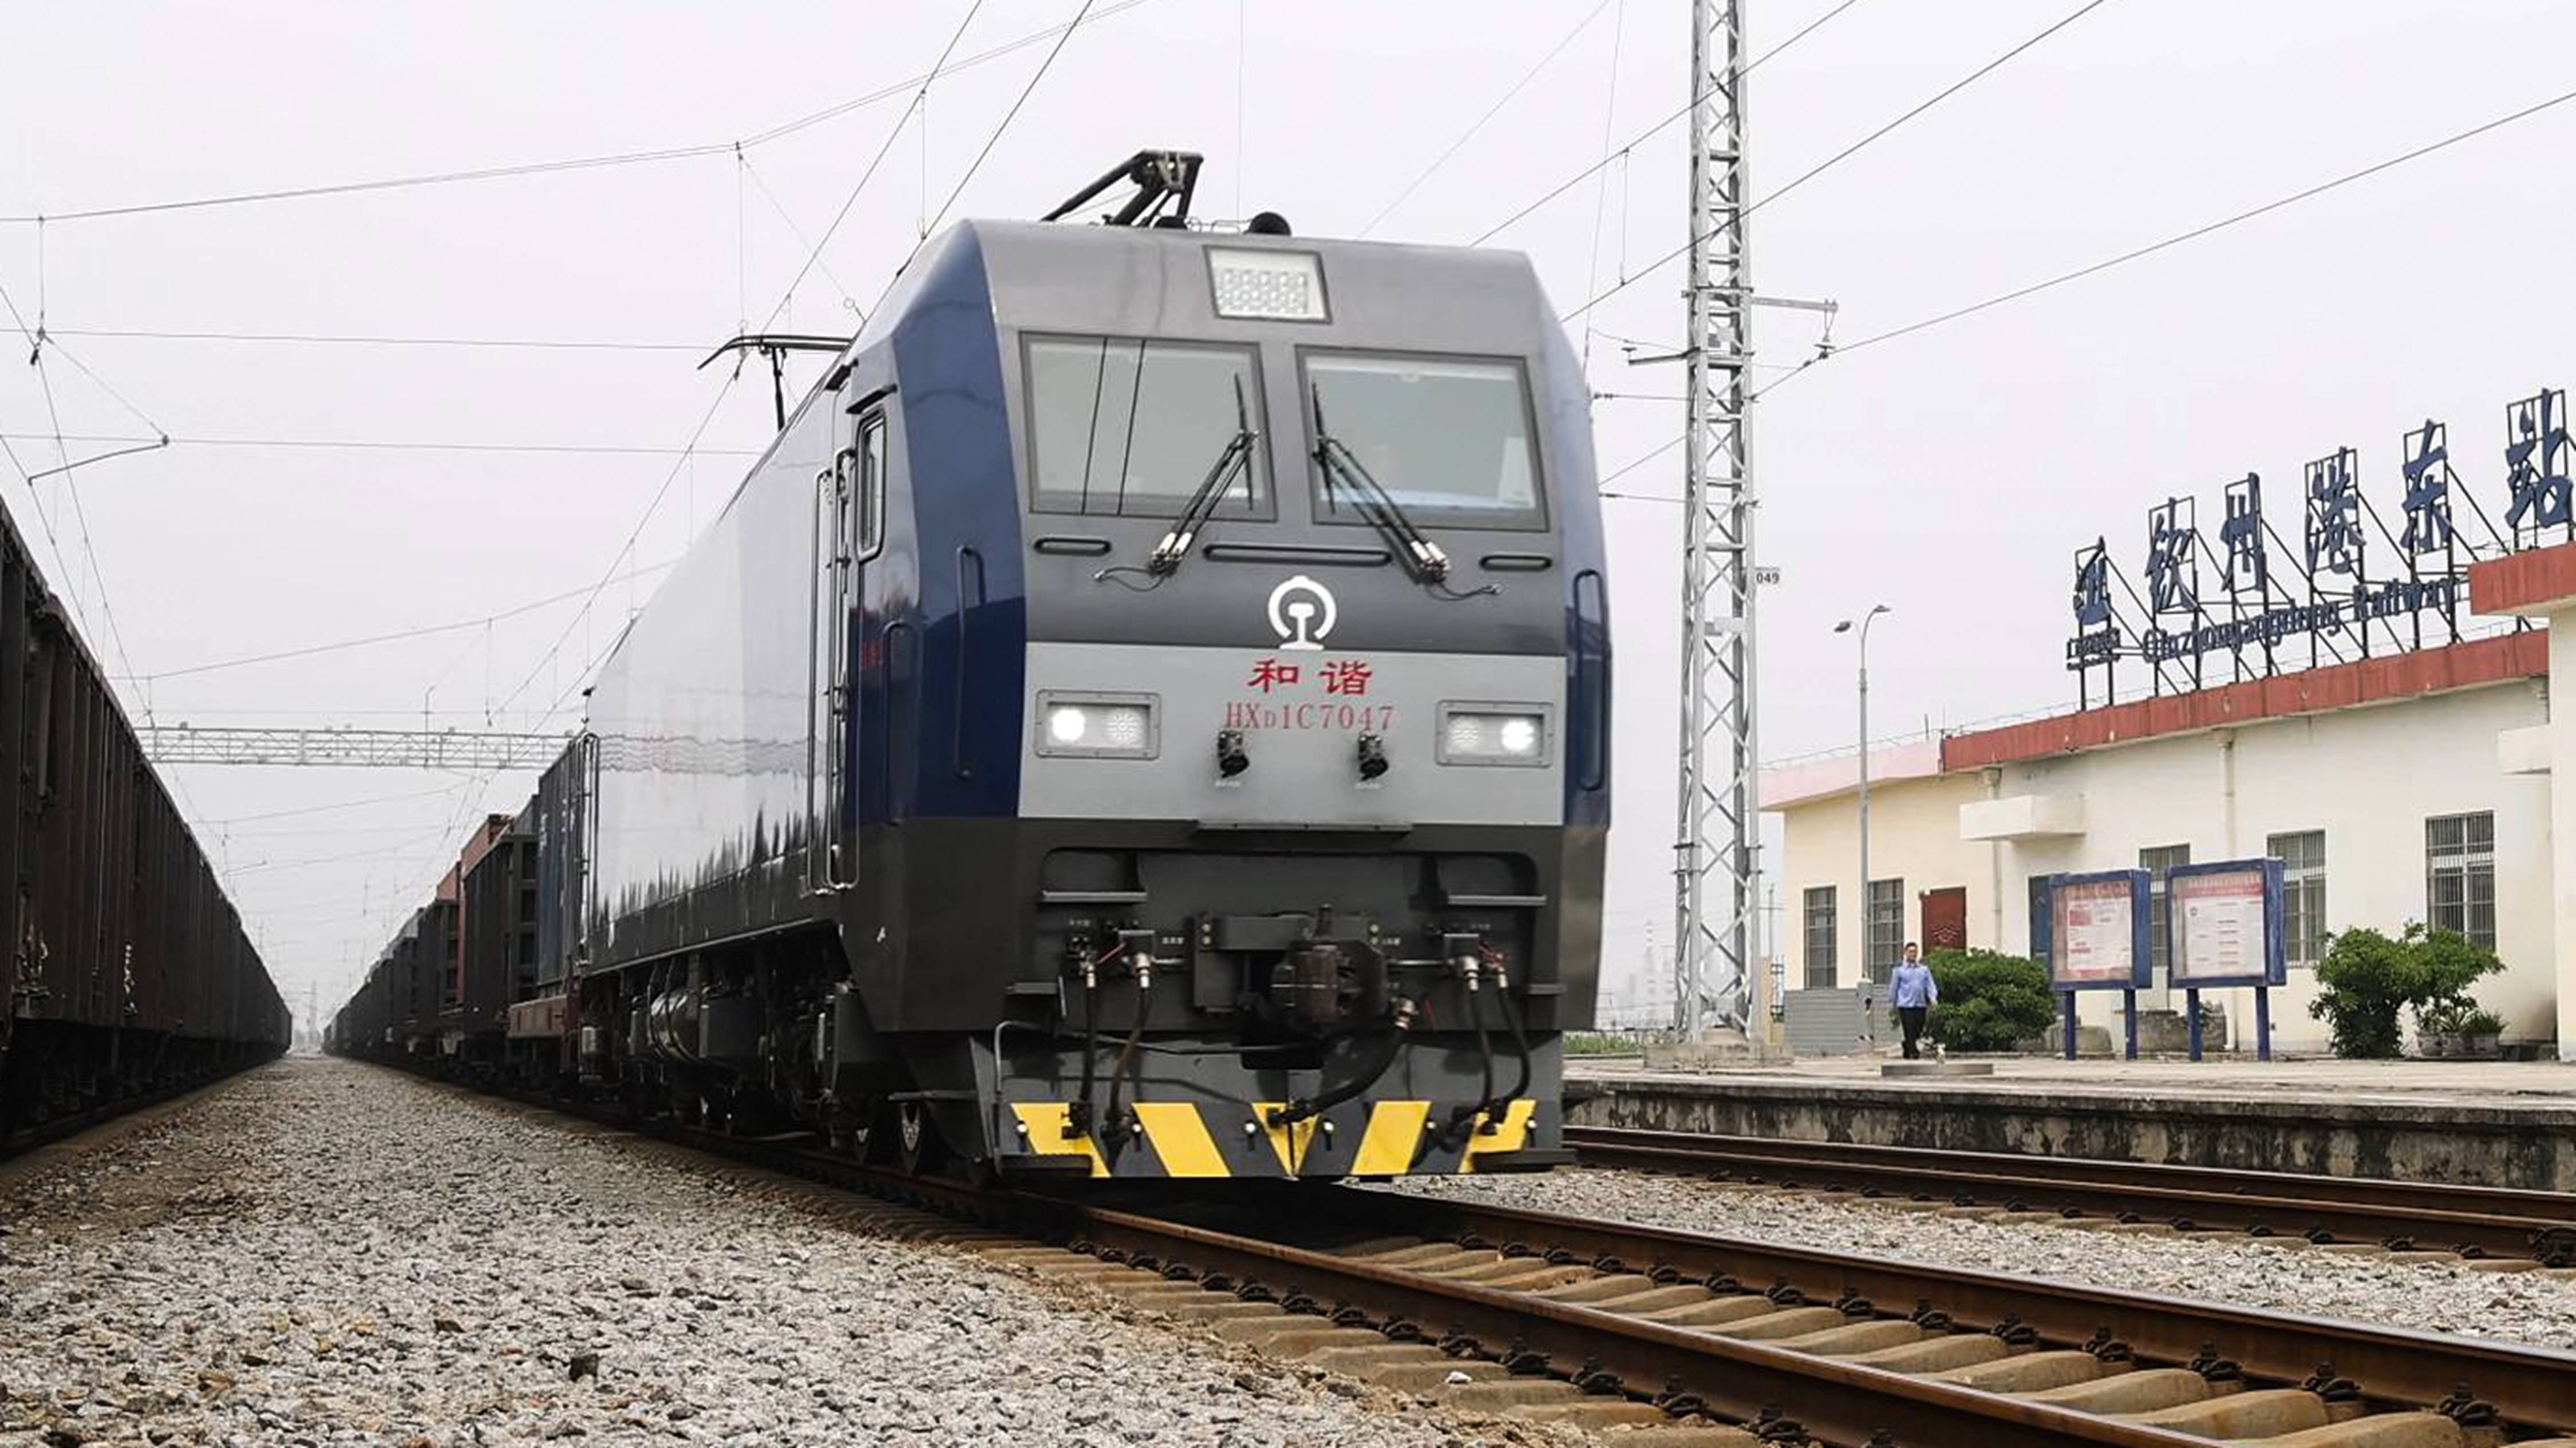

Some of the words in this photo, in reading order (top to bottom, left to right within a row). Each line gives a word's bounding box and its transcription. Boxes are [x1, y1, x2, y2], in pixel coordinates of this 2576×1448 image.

[2145, 389, 2575, 611] 钦州港东站
[2353, 577, 2459, 621] Railway
[1247, 659, 1373, 695] 和谐
[1225, 702, 1394, 731] HXD1C7047
